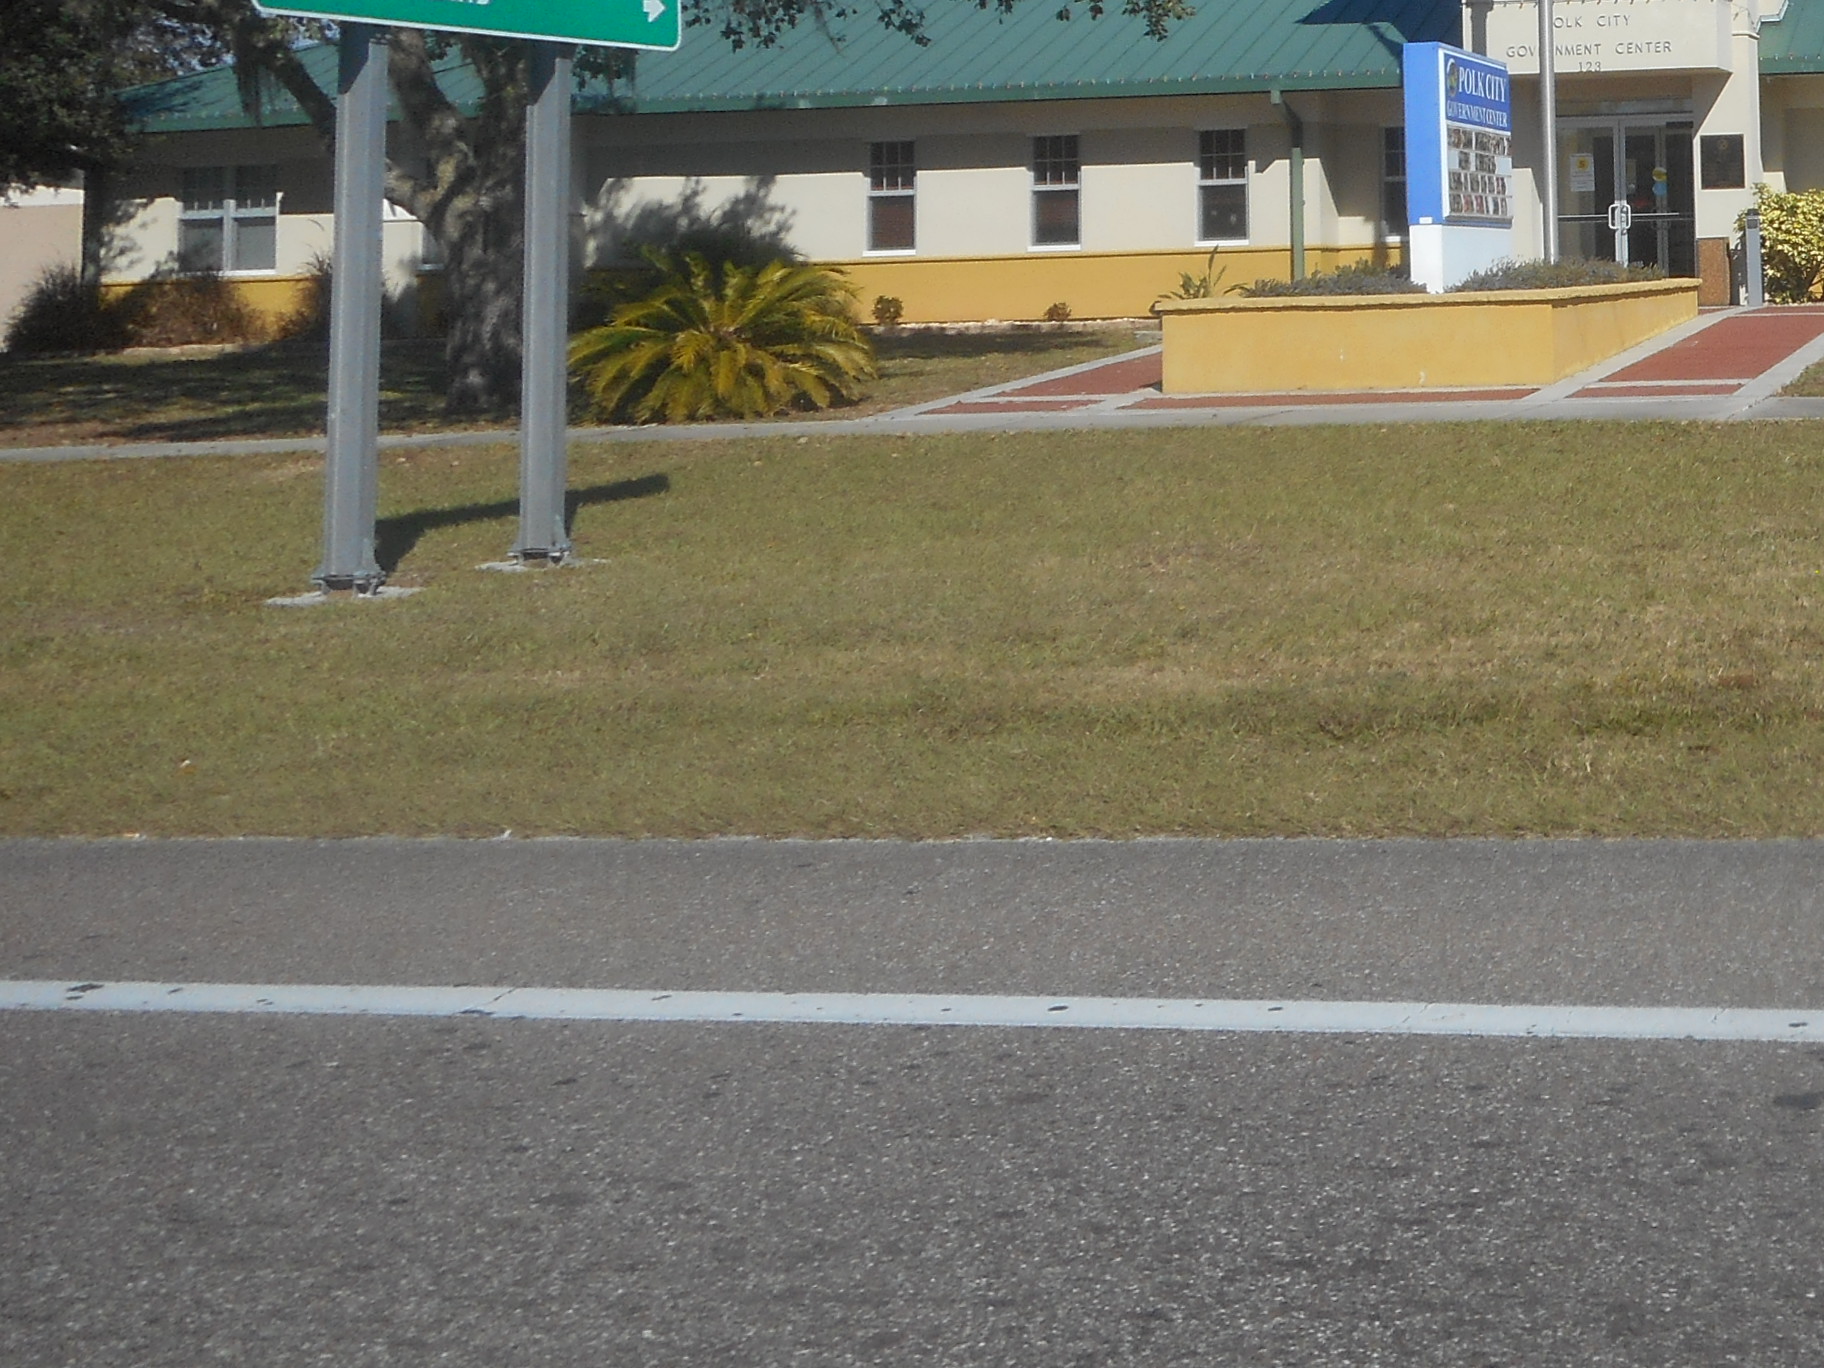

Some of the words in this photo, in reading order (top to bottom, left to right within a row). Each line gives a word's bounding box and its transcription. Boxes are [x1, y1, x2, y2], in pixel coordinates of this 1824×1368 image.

[1544, 15, 1583, 29] OLK
[1596, 15, 1631, 27] CITY
[1506, 43, 1601, 58] GOVNMENT
[1615, 41, 1672, 55] CENTER
[1578, 62, 1601, 73] 123
[1459, 66, 1485, 98] POLK
[1485, 73, 1507, 103] CITY
[1486, 108, 1508, 128] CENTER
